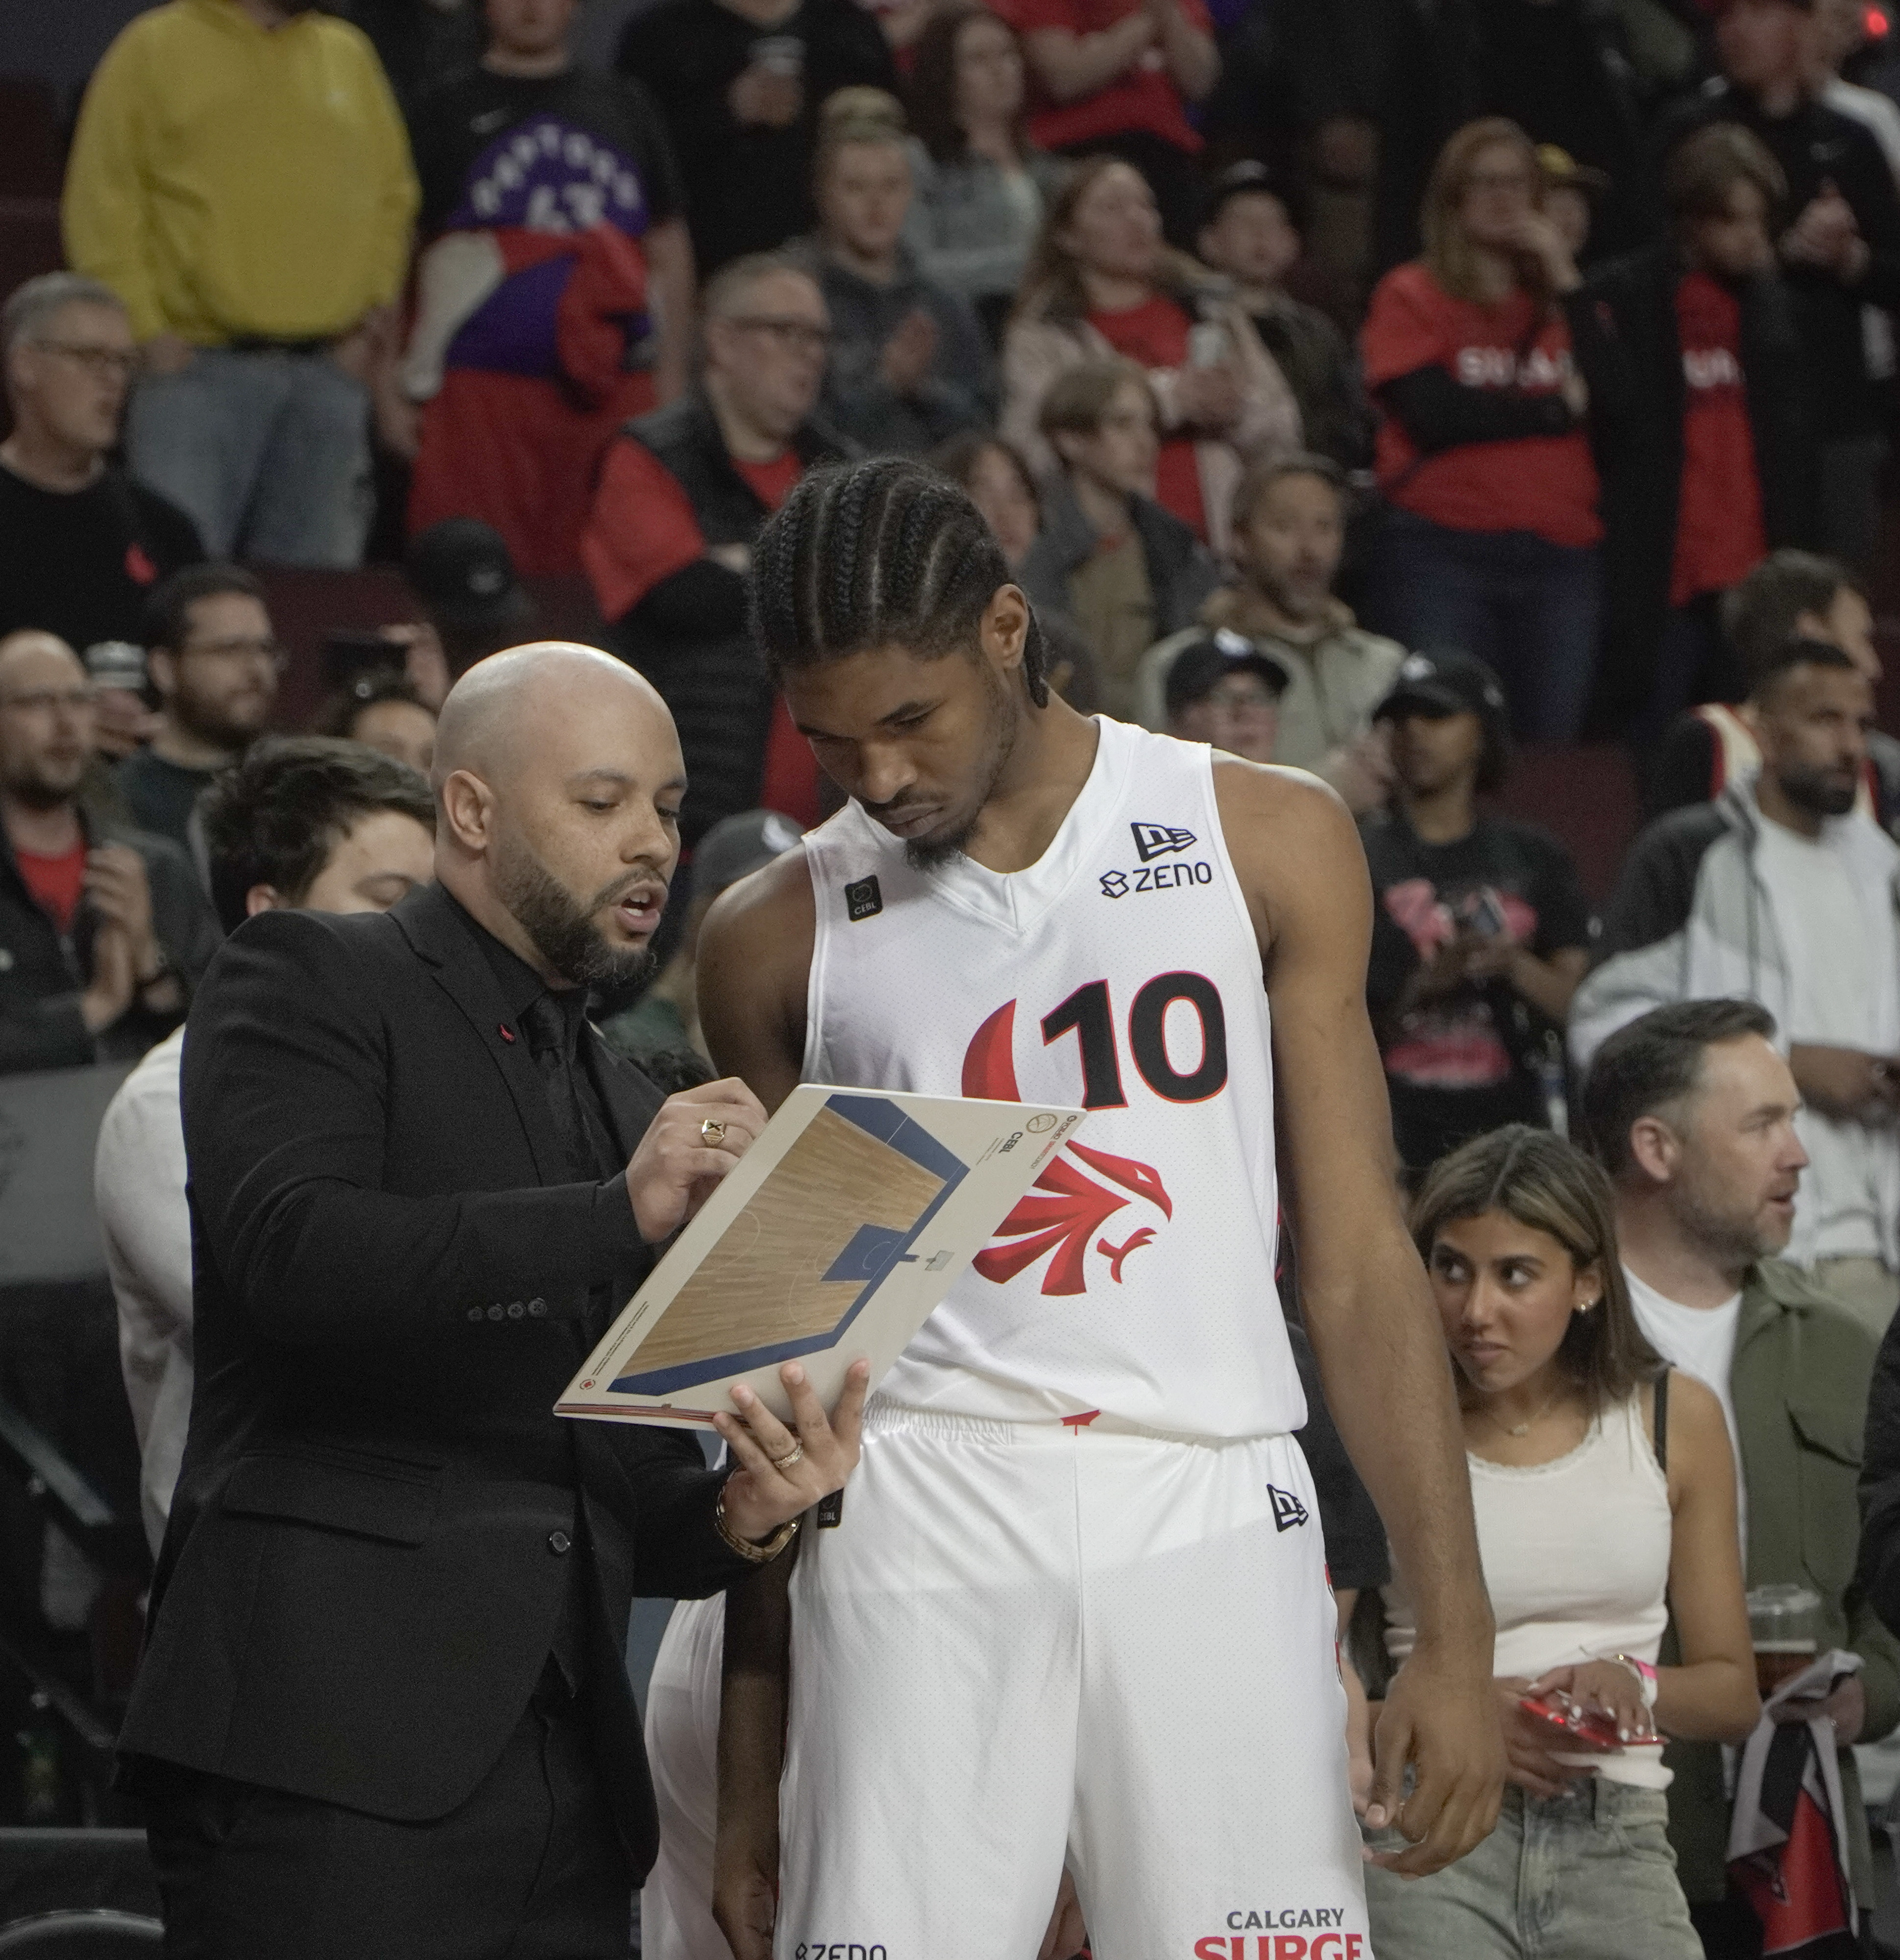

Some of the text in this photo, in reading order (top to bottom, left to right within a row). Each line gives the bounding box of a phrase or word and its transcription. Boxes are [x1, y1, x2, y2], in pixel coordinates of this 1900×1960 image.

[1133, 862, 1212, 892] ZENO
[855, 902, 876, 914] CEBL
[1040, 970, 1228, 1111] 10
[998, 1132, 1023, 1153] CEBL
[1227, 1909, 1344, 1930] CALGARY
